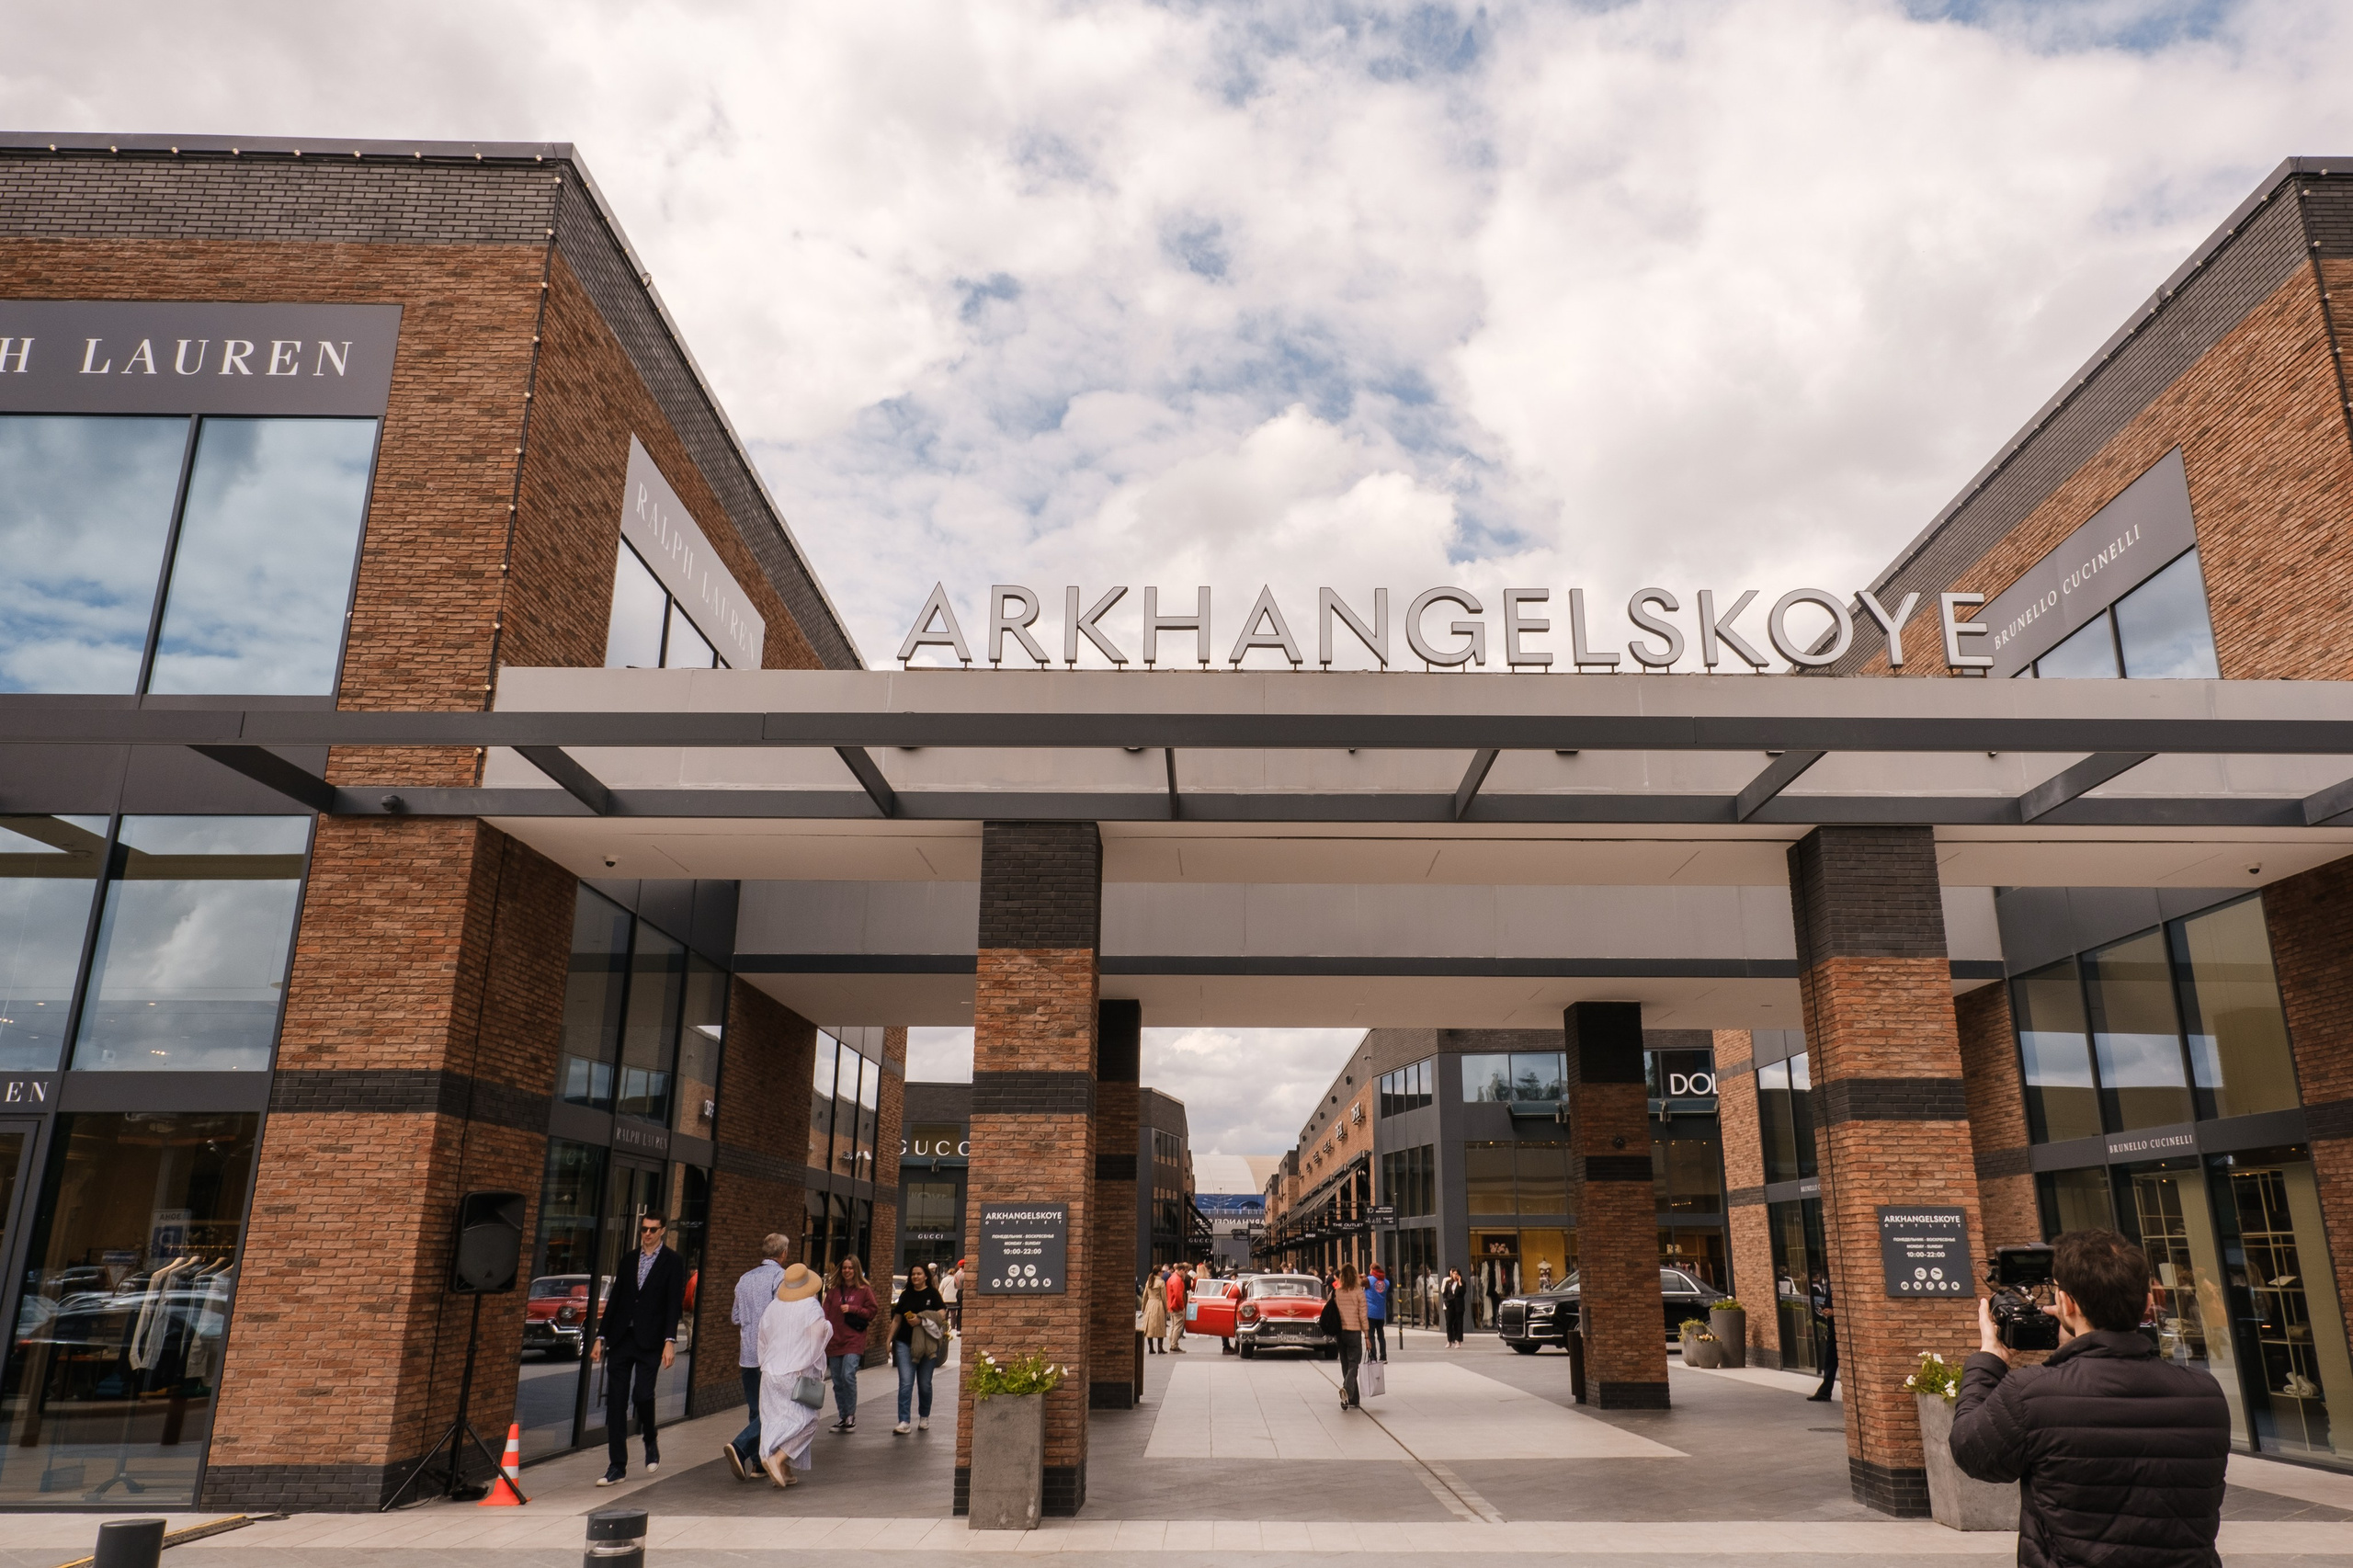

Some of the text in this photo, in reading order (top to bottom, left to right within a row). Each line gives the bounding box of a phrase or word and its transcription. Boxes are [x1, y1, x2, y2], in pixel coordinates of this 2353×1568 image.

[79, 338, 353, 376] LAUREN
[636, 481, 756, 662] RALPH LAUREN
[1994, 523, 2141, 651] BRUNELLO CUCINELLI
[896, 581, 1995, 676] ARKHANGELSKOYE
[5, 1081, 49, 1103] EN
[1669, 1072, 1719, 1096] DOL
[2109, 1134, 2193, 1153] BRUNELLO CUCINELLI
[985, 1211, 1063, 1220] ARKHANGELSKOYE
[1884, 1215, 1961, 1223] ARKHANGELSKOYE
